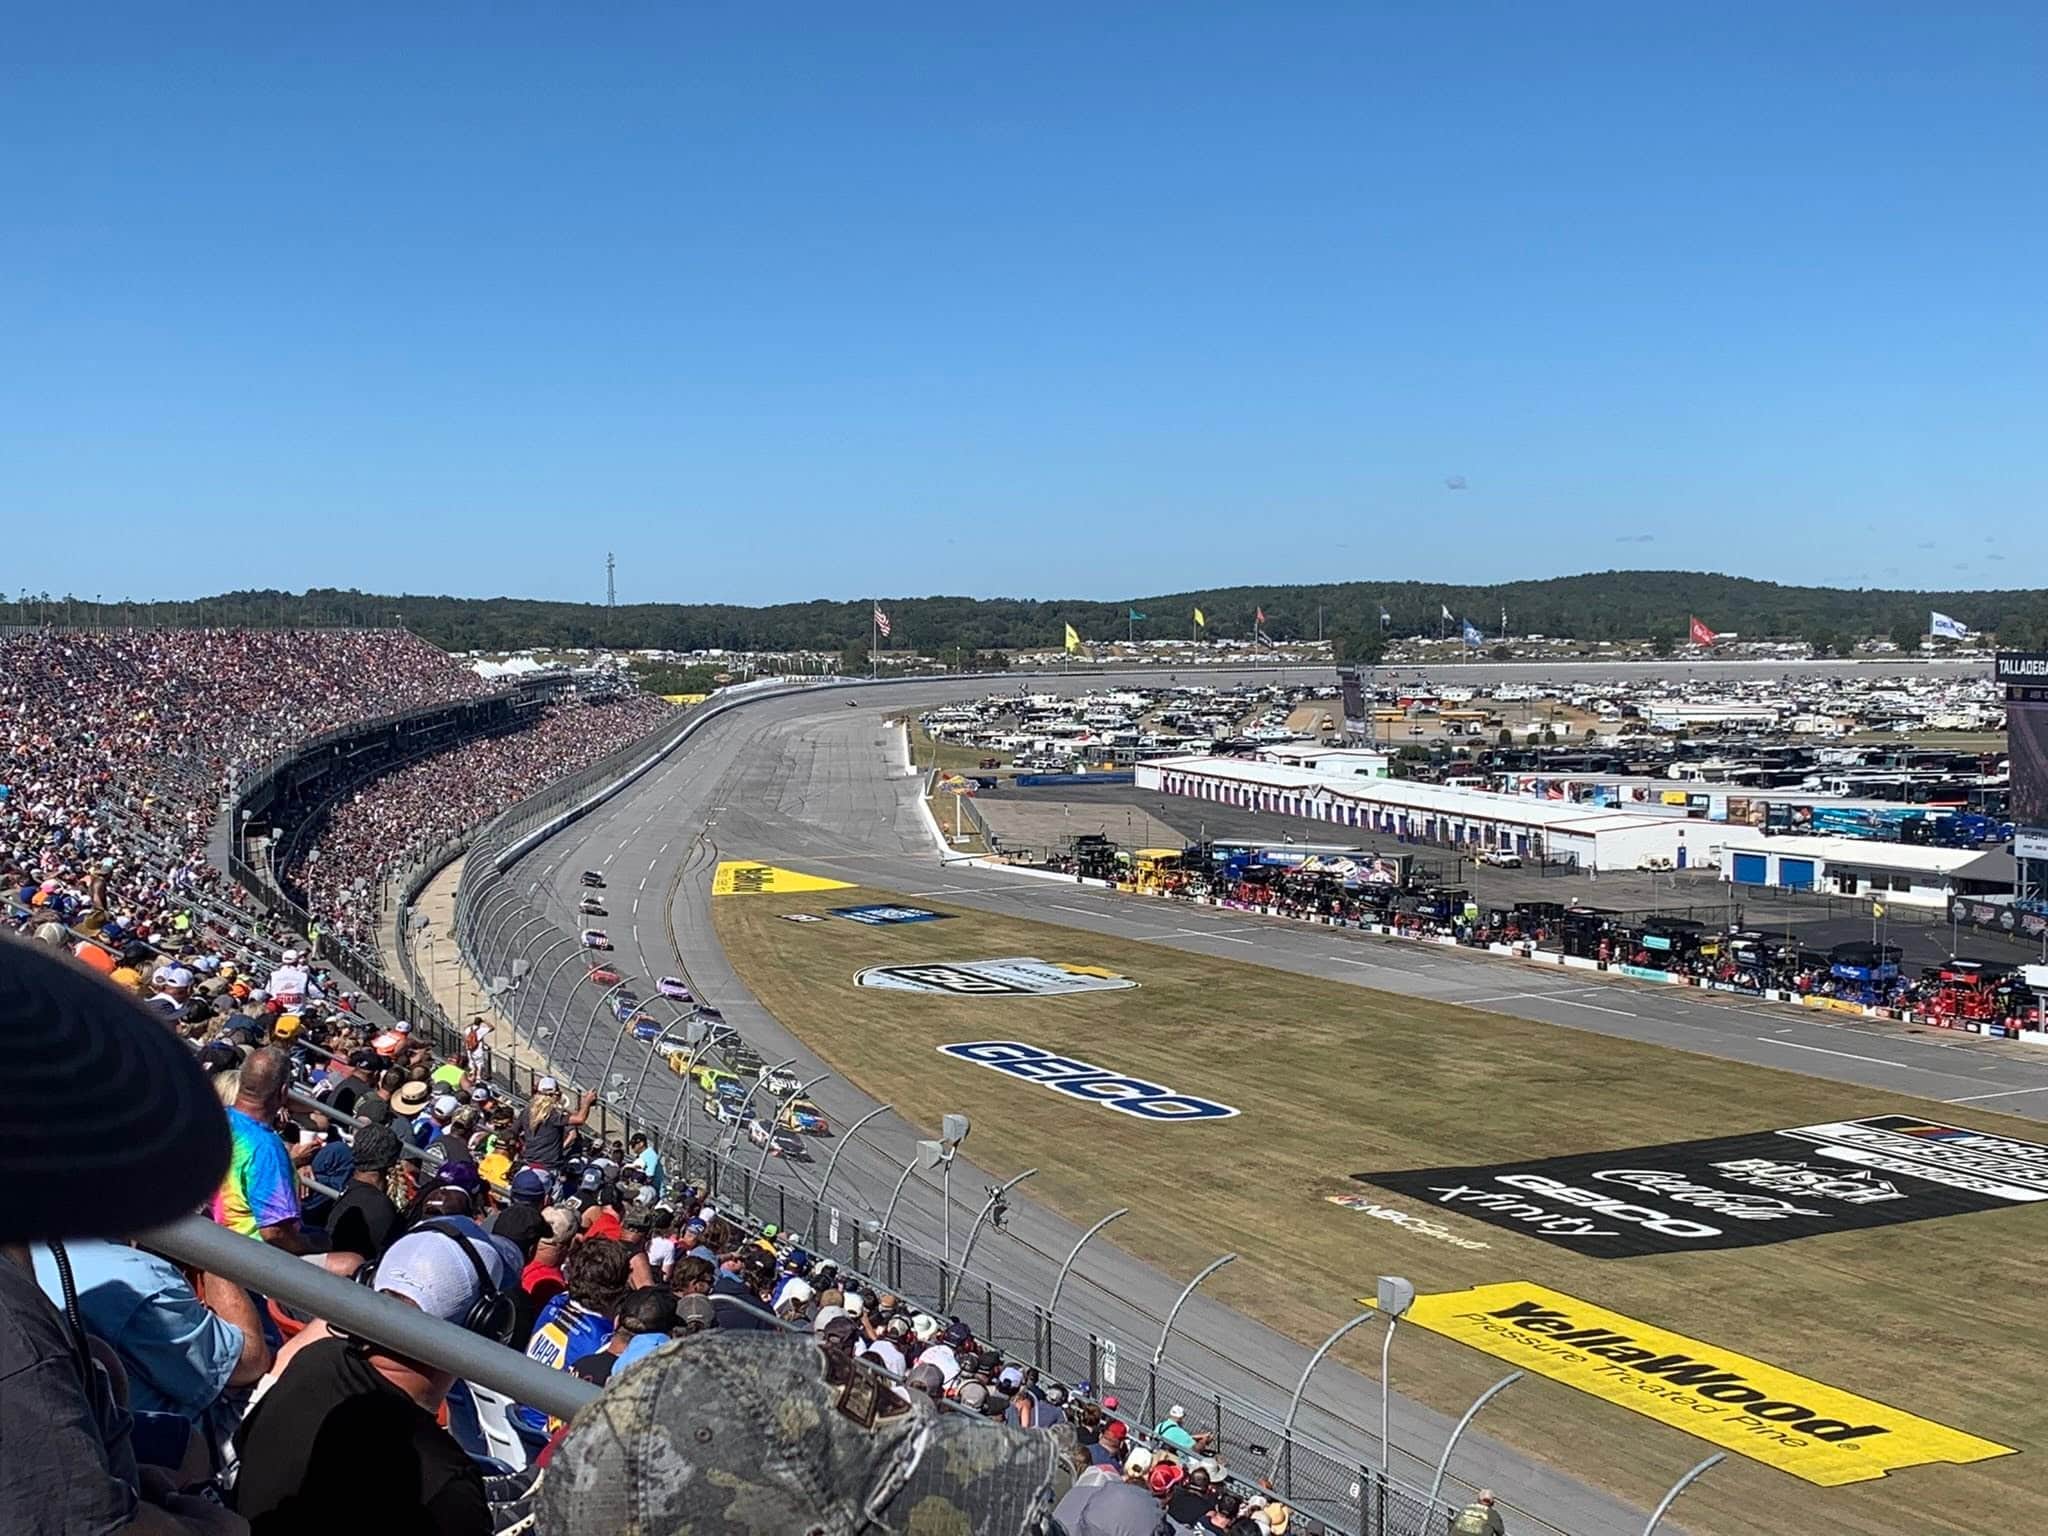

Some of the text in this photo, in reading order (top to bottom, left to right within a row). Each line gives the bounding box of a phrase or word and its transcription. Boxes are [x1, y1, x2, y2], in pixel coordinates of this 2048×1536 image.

[1999, 660, 2048, 675] TALLADEGA
[904, 967, 1012, 992] 250
[937, 1041, 1241, 1121] GEICO
[1838, 1132, 2048, 1181] CUP SERIES
[1937, 1134, 2048, 1164] NASC
[1708, 1158, 1908, 1204] BUSCH
[1856, 1157, 2004, 1189] PLAYOFFS
[1354, 1205, 1427, 1228] NBC
[1494, 1175, 1723, 1238] GEICO
[528, 1333, 562, 1366] NAPA
[1452, 1312, 1809, 1449] Pressure Treated Pine
[1486, 1301, 1892, 1442] YellaWood
